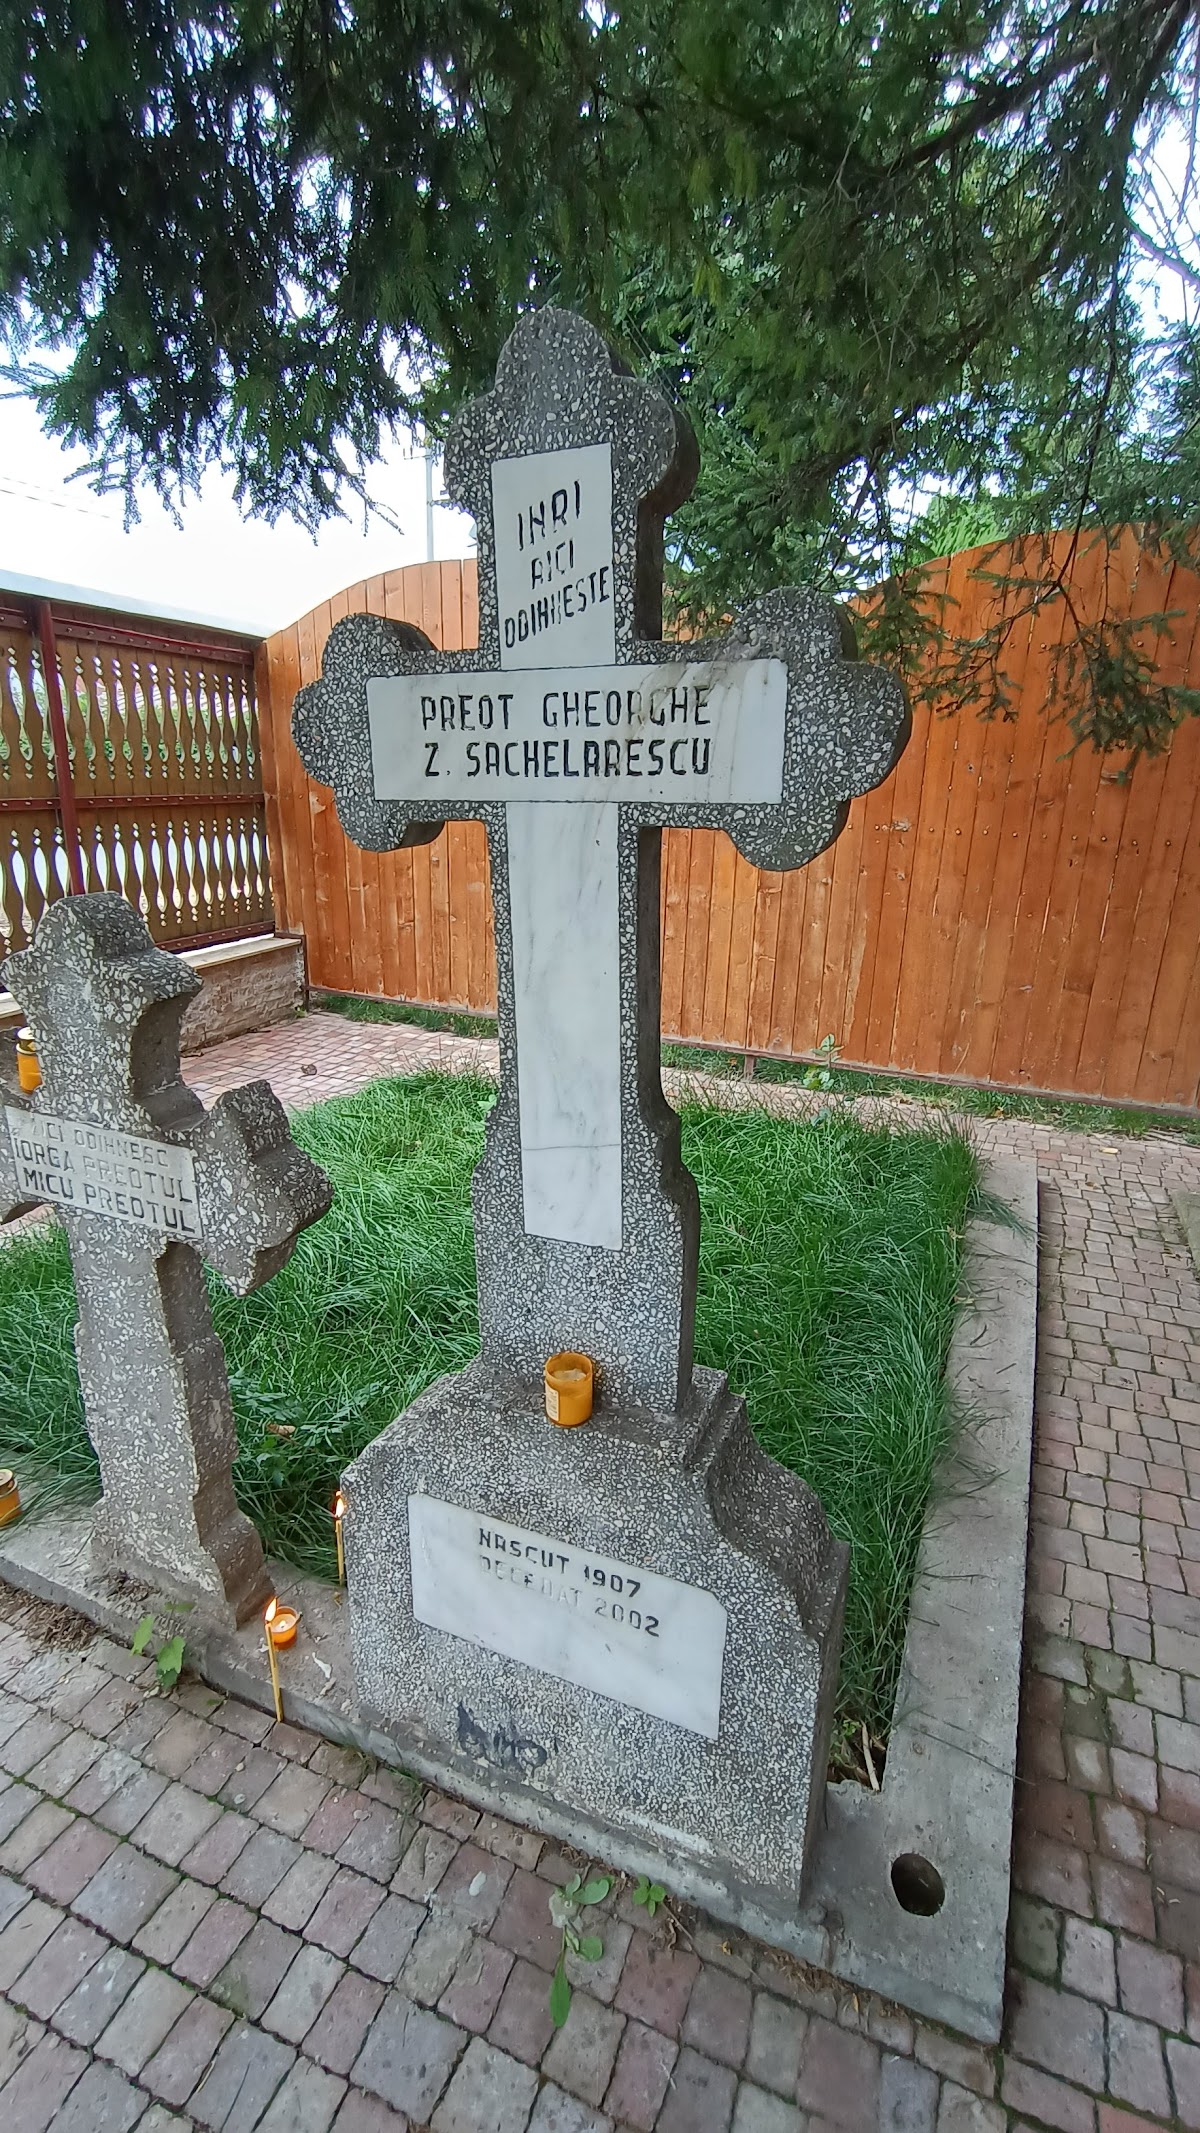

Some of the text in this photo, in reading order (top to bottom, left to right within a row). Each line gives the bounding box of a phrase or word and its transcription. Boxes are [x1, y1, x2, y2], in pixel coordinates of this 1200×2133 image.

[518, 480, 580, 551] INRI
[532, 538, 574, 589] AICI
[421, 685, 712, 731] PREOT GHEORGHE
[424, 738, 711, 777] Z. SACHELARESCU
[14, 1138, 193, 1203] IORGA PREOTUL
[74, 1130, 169, 1167] ODIHNESC
[23, 1167, 195, 1233] MICU PREOTUL
[479, 1528, 641, 1598] NASCUT 1907
[594, 1597, 660, 1638] 2002
